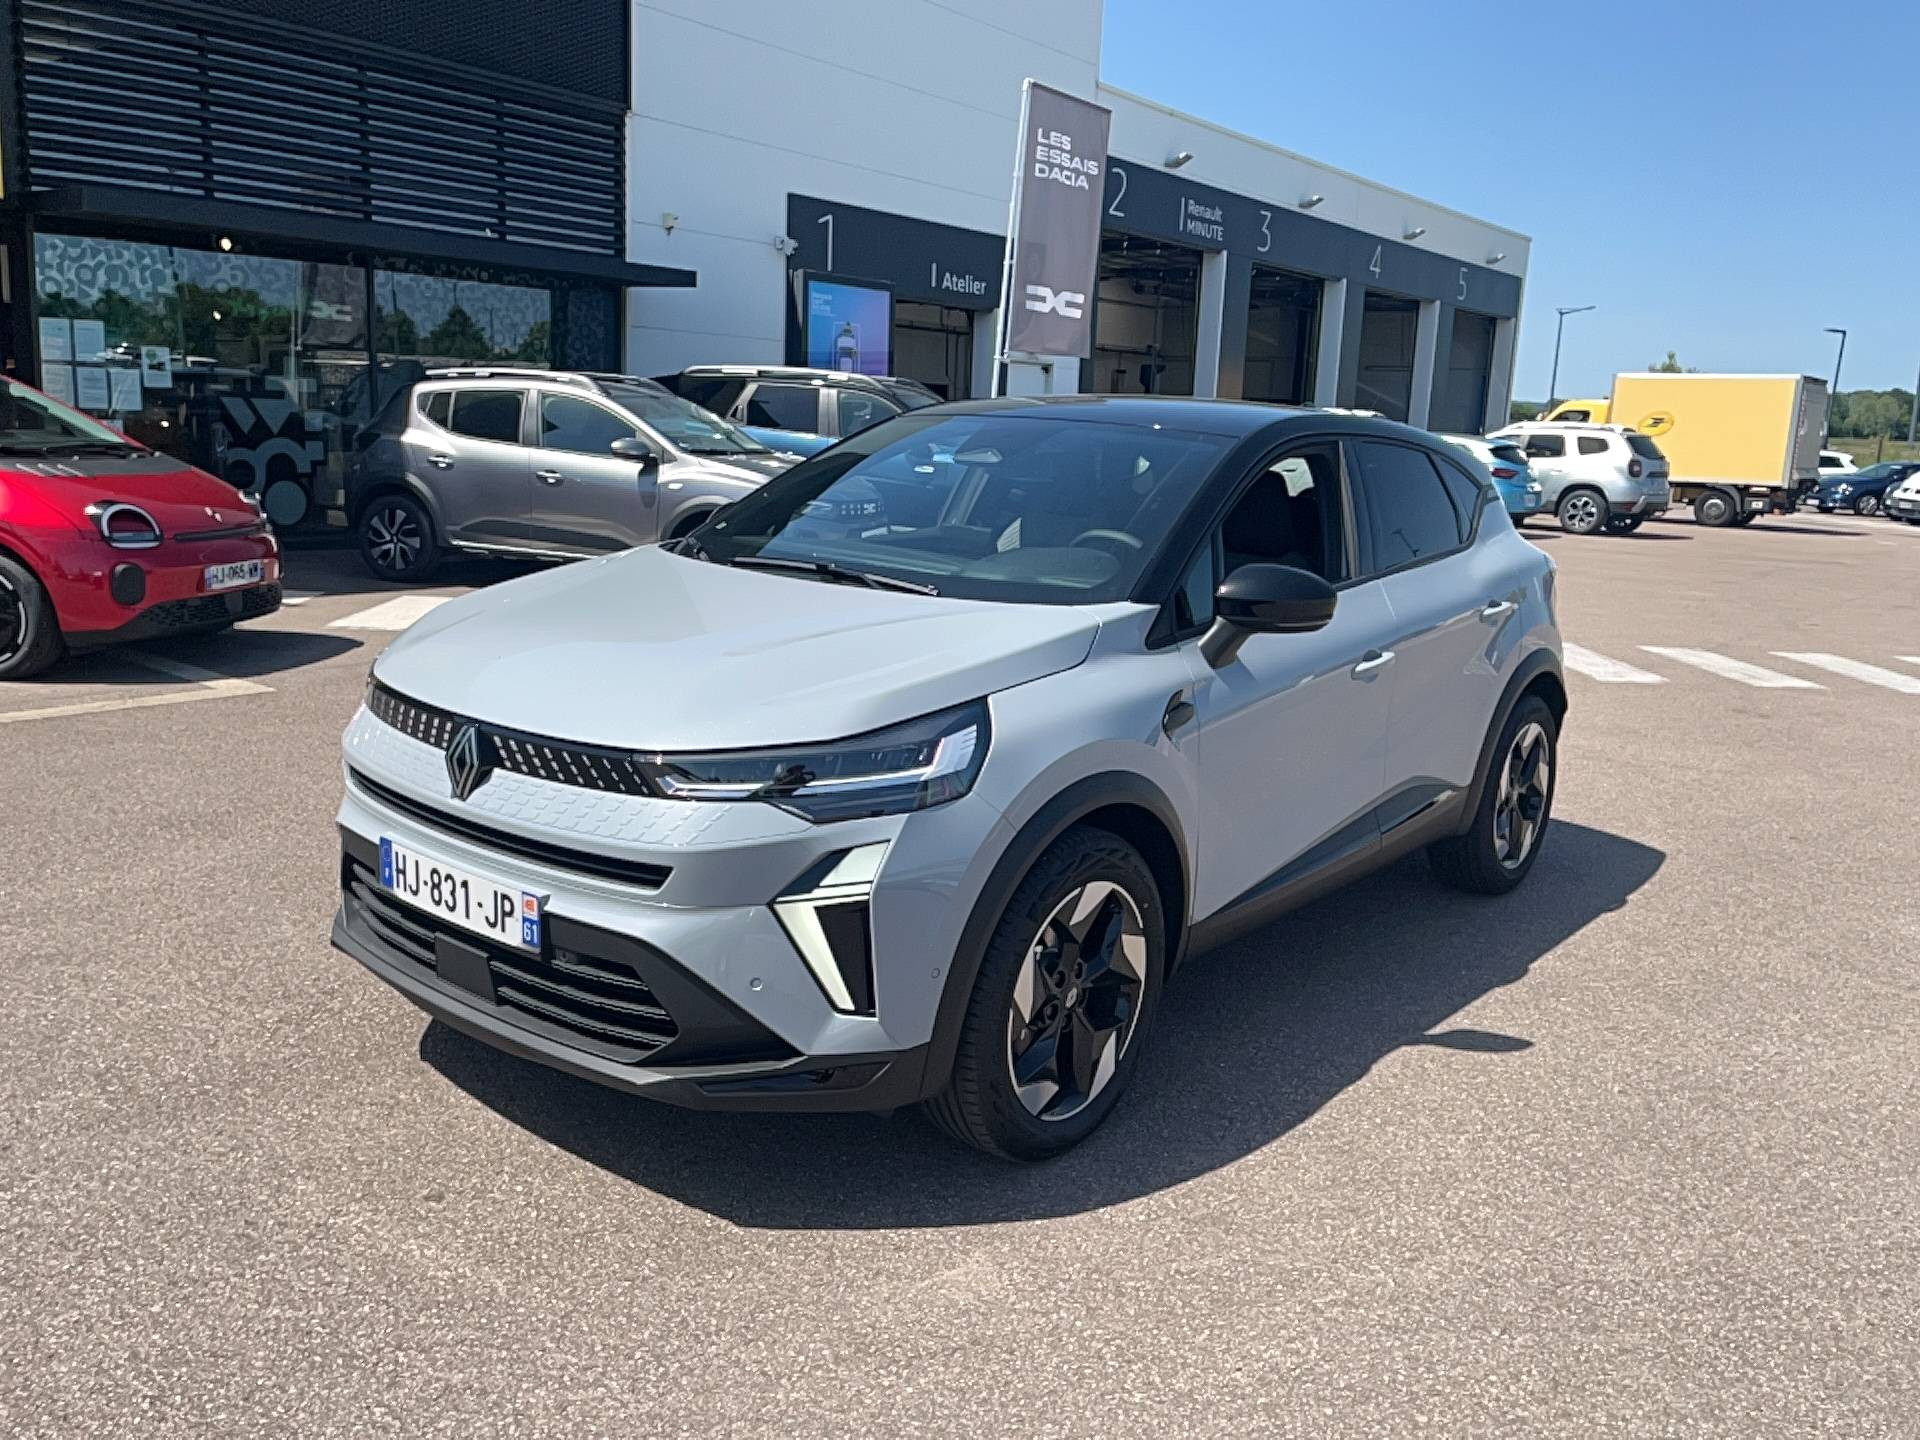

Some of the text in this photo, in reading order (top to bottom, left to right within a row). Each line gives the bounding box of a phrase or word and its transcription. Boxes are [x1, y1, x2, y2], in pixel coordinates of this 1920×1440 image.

[1037, 128, 1071, 151] LES
[1036, 145, 1099, 175] ESSAIS
[1034, 162, 1089, 190] DACIA
[1109, 167, 1127, 217] 2
[1187, 199, 1223, 222] Renault
[817, 214, 834, 272] 1
[1186, 219, 1225, 241] MINUTE
[1256, 210, 1272, 252] 3
[1369, 244, 1382, 280] 4
[942, 271, 987, 295] Atelier
[1457, 267, 1469, 300] 5
[394, 851, 539, 945] HJ-831-JP 61
